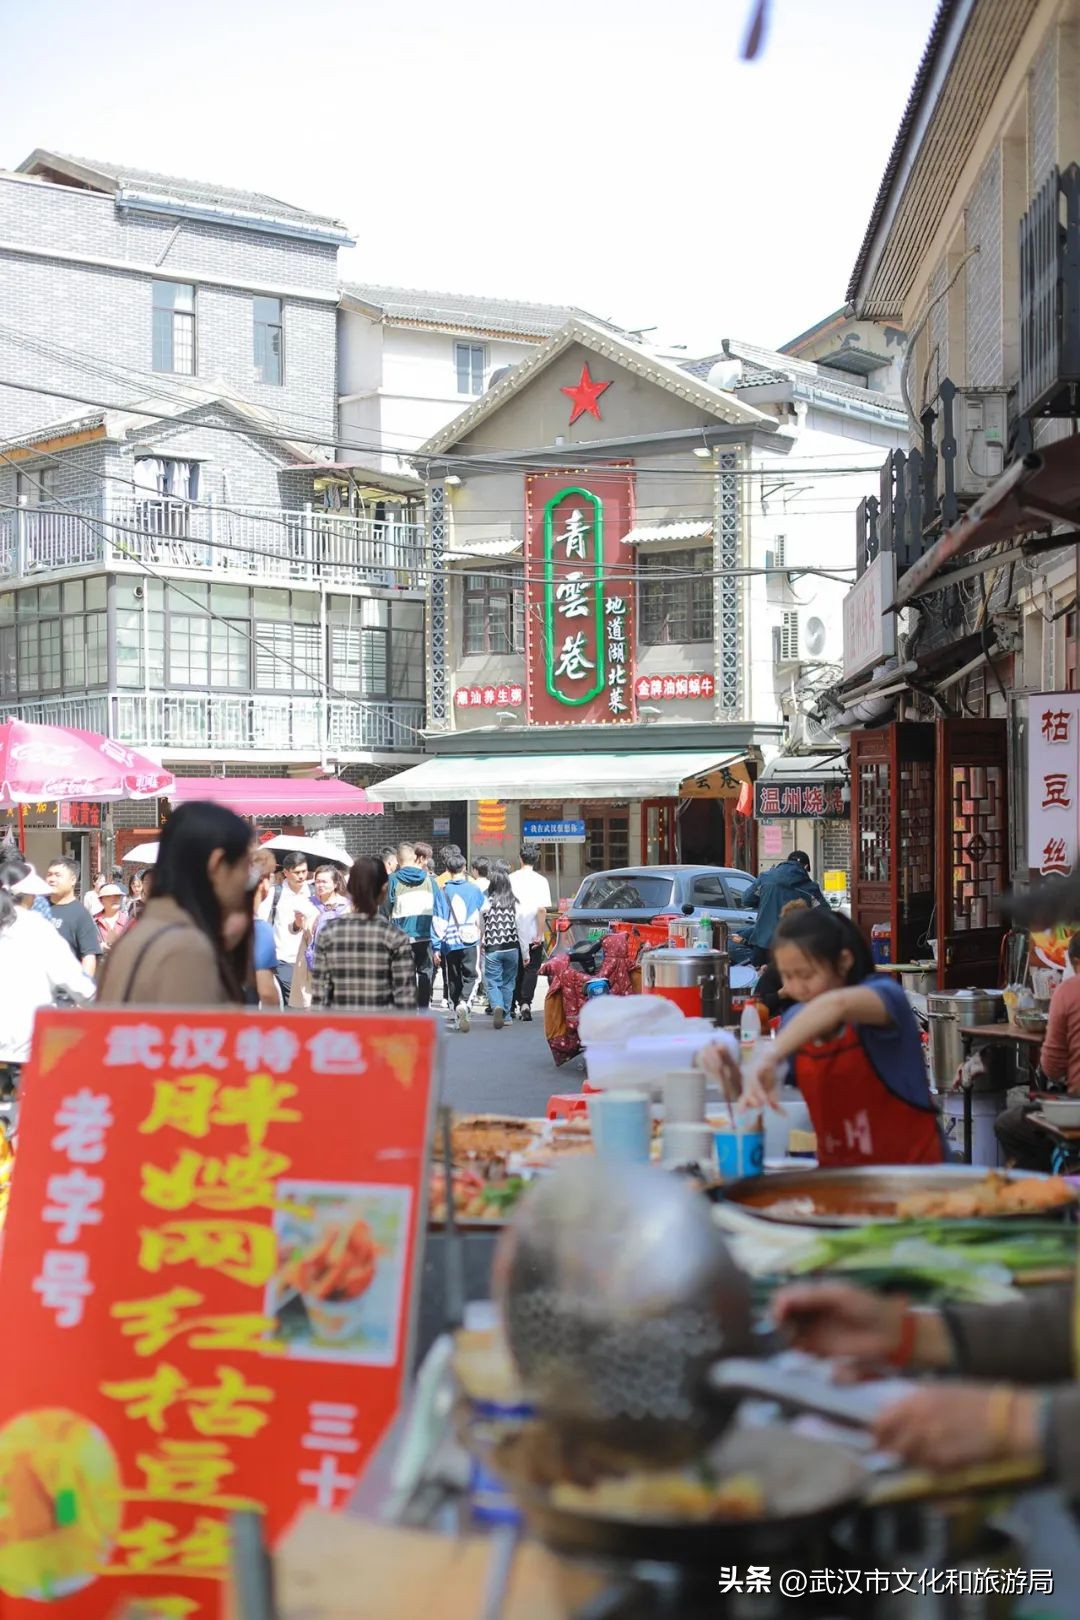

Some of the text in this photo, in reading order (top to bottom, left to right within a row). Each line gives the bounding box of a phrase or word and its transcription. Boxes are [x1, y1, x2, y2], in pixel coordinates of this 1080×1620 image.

[555, 509, 594, 681] 青雲巷
[605, 596, 628, 714] 地道湖北菜
[760, 787, 845, 814] 温州烧烤
[1041, 709, 1072, 875] 枯豆丝
[104, 1023, 367, 1076] 武汉特色
[33, 1087, 114, 1328] 老字号
